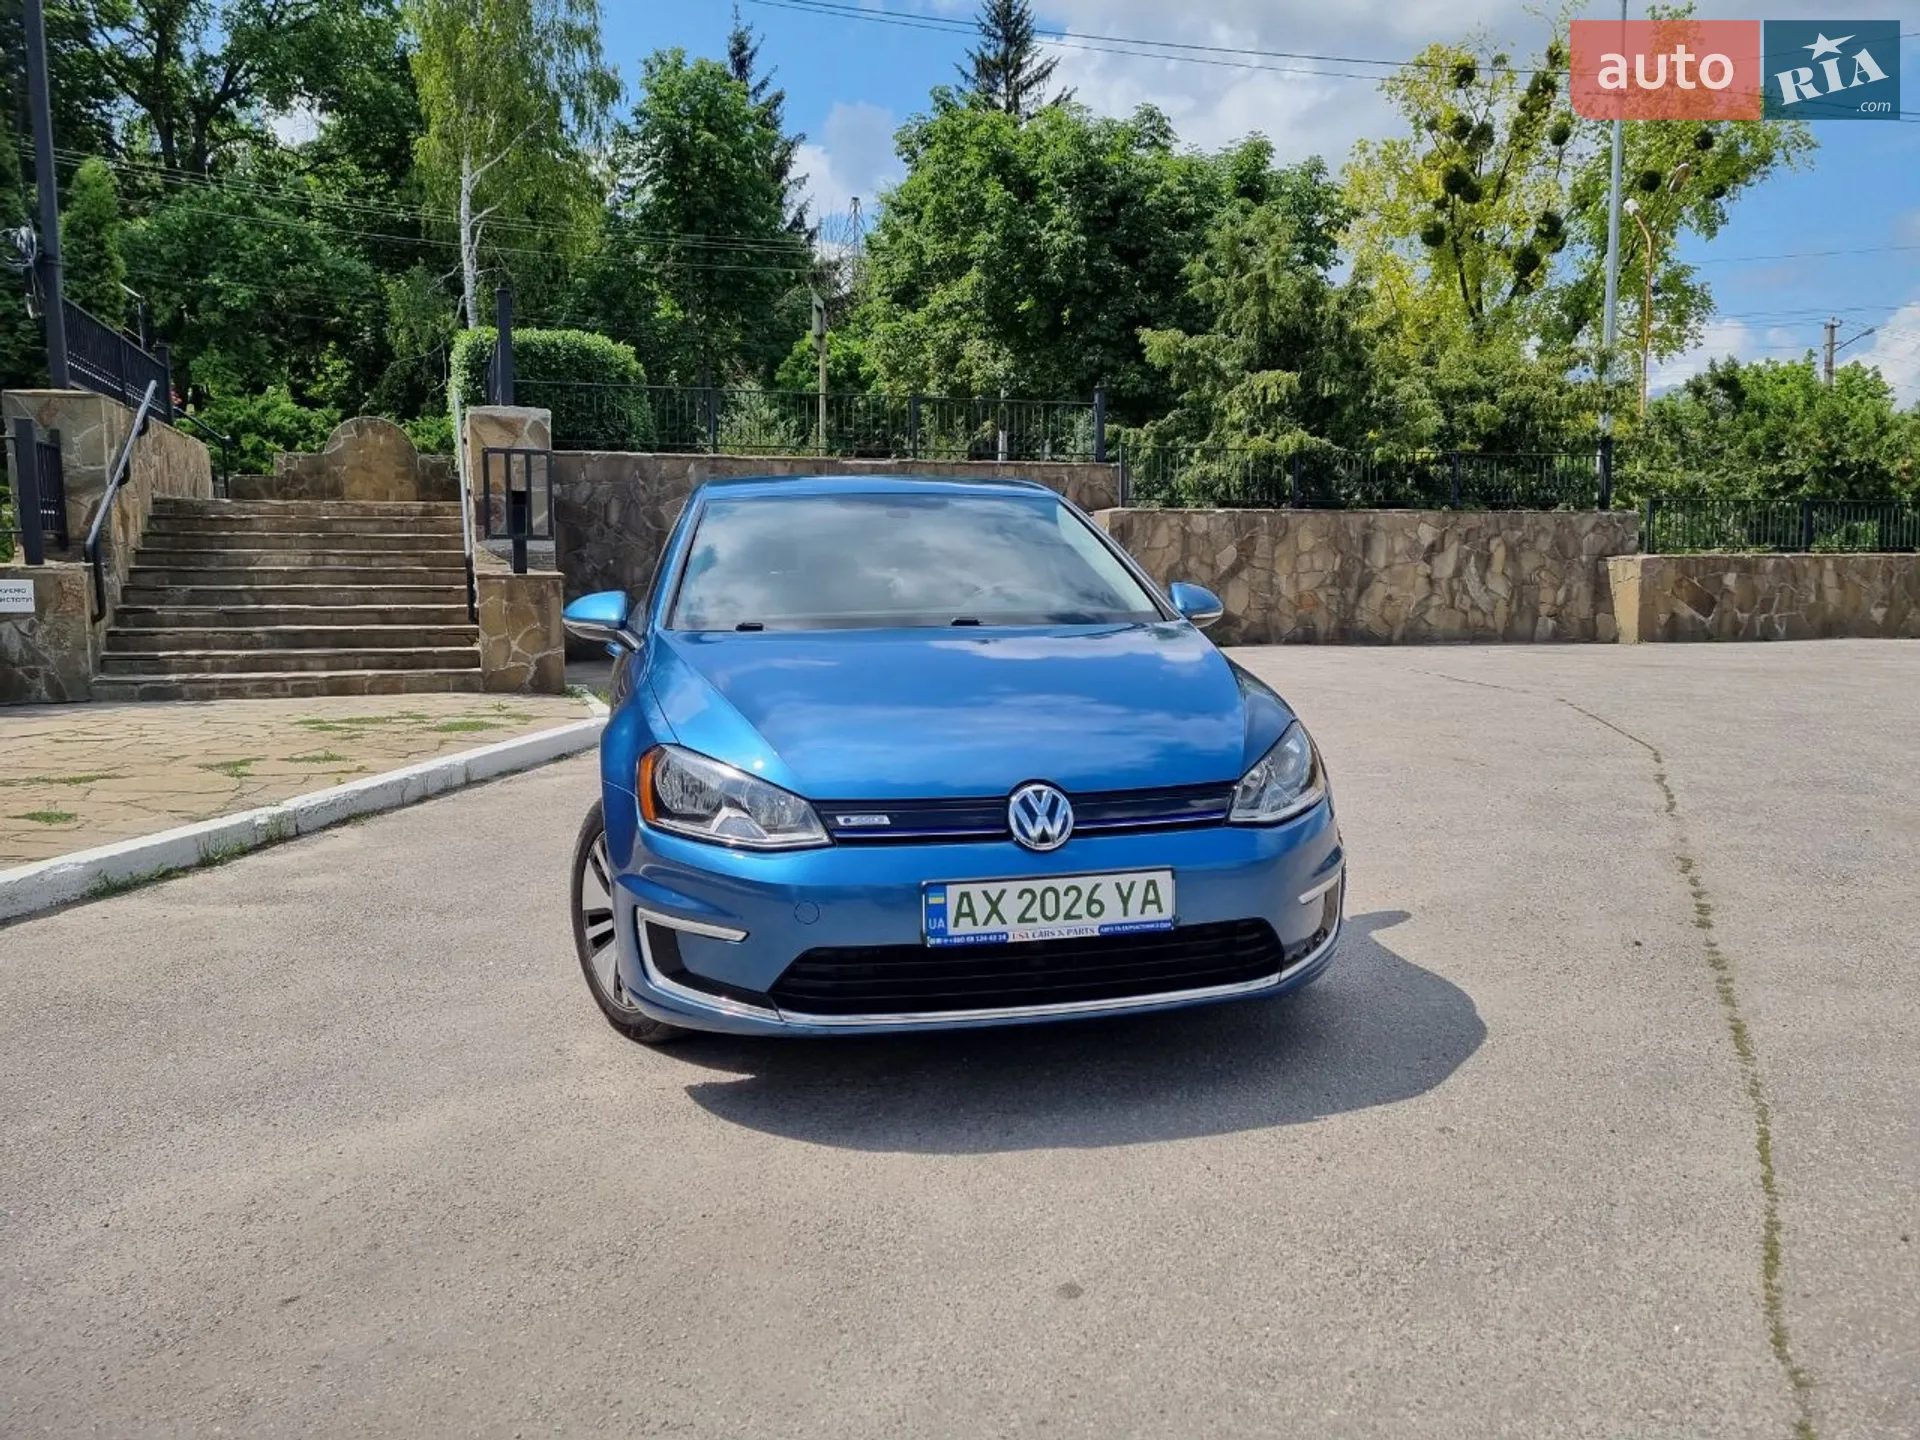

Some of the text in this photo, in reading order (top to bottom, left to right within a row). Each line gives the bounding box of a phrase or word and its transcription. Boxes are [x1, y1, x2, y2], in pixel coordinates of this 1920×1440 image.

[952, 878, 1164, 929] AX 2026 YA
[928, 916, 945, 930] UA
[1012, 931, 1030, 940] USA
[1032, 929, 1055, 939] CARS
[1066, 927, 1095, 936] PARTS
